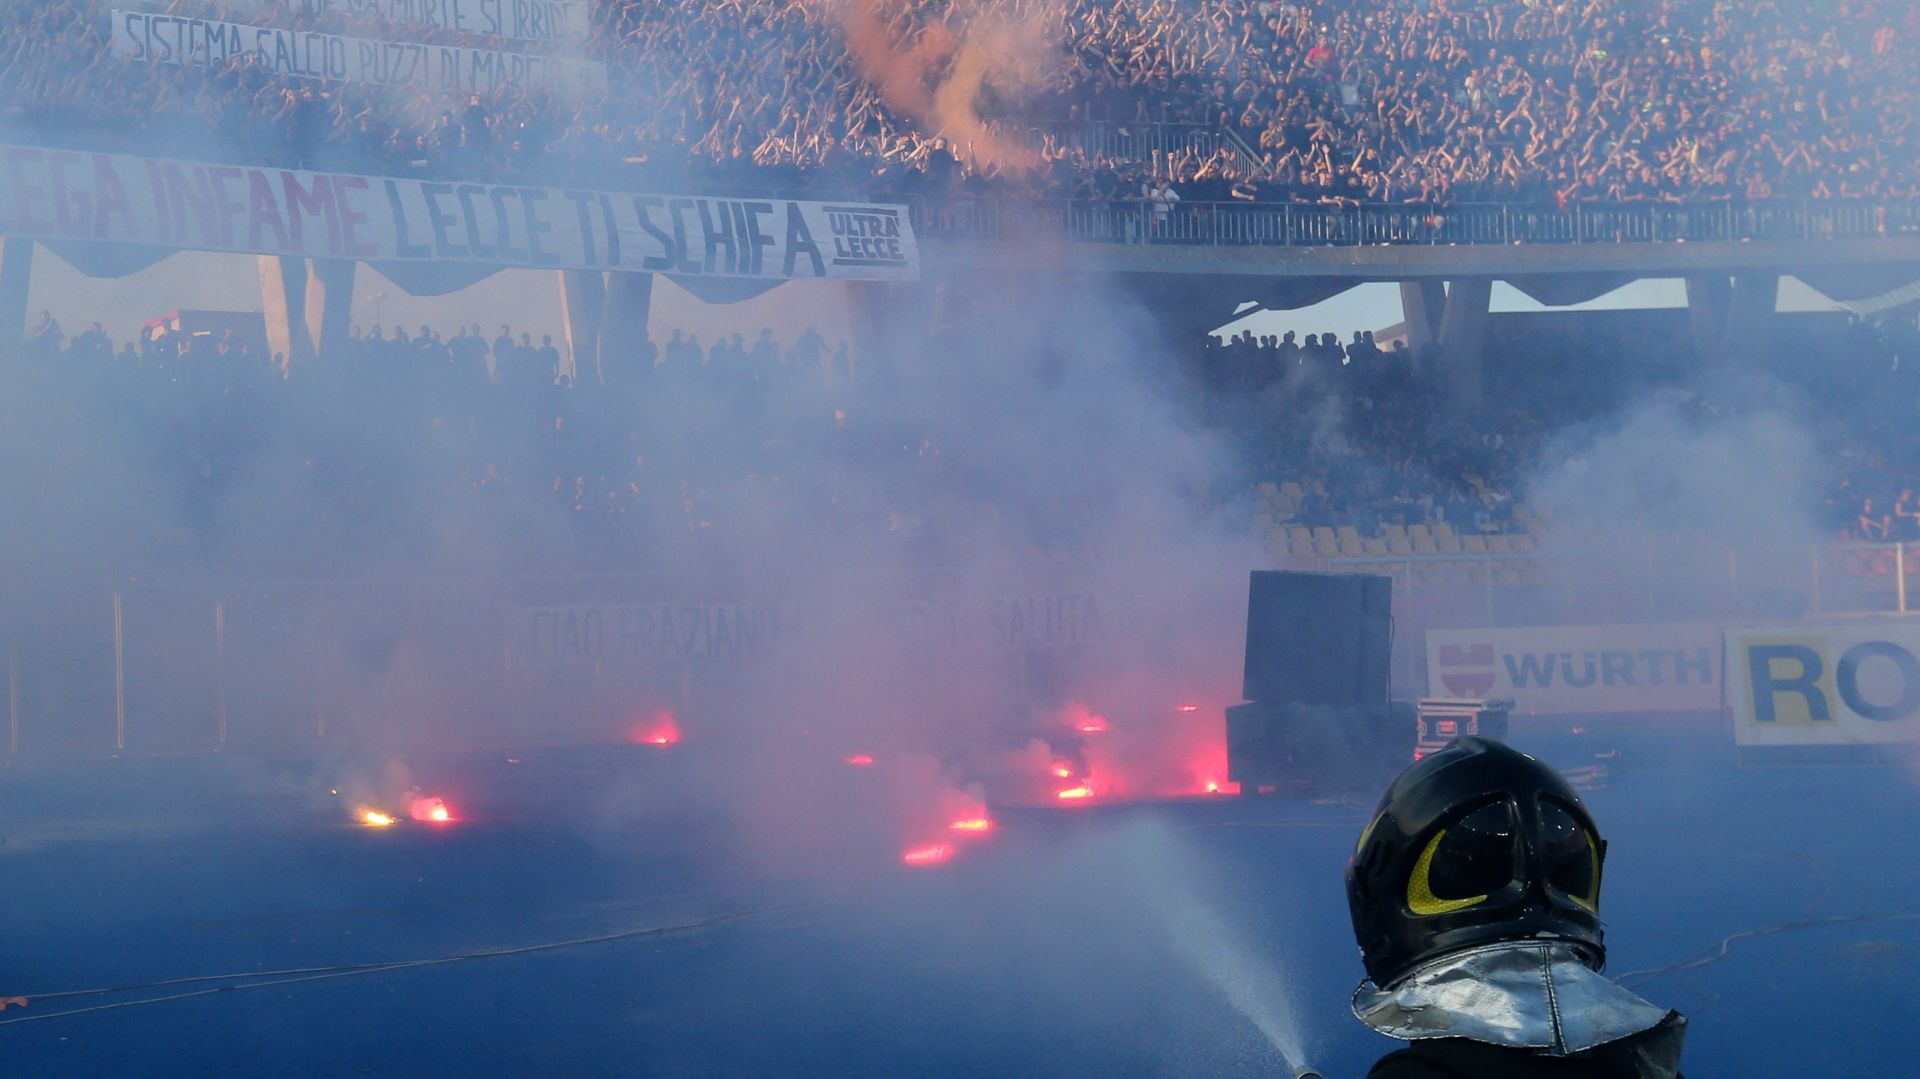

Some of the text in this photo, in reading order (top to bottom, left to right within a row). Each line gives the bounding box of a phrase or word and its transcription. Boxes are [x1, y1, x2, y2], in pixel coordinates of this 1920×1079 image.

[125, 14, 244, 69] SISTEMA
[359, 41, 429, 89] PUZZI
[440, 48, 460, 90] DI
[0, 148, 138, 239] EGA
[144, 159, 378, 257] INFAME
[384, 180, 559, 264] LECCE
[564, 191, 621, 266] TI
[831, 237, 905, 261] LECCE
[1502, 648, 1713, 689] WÜRTH
